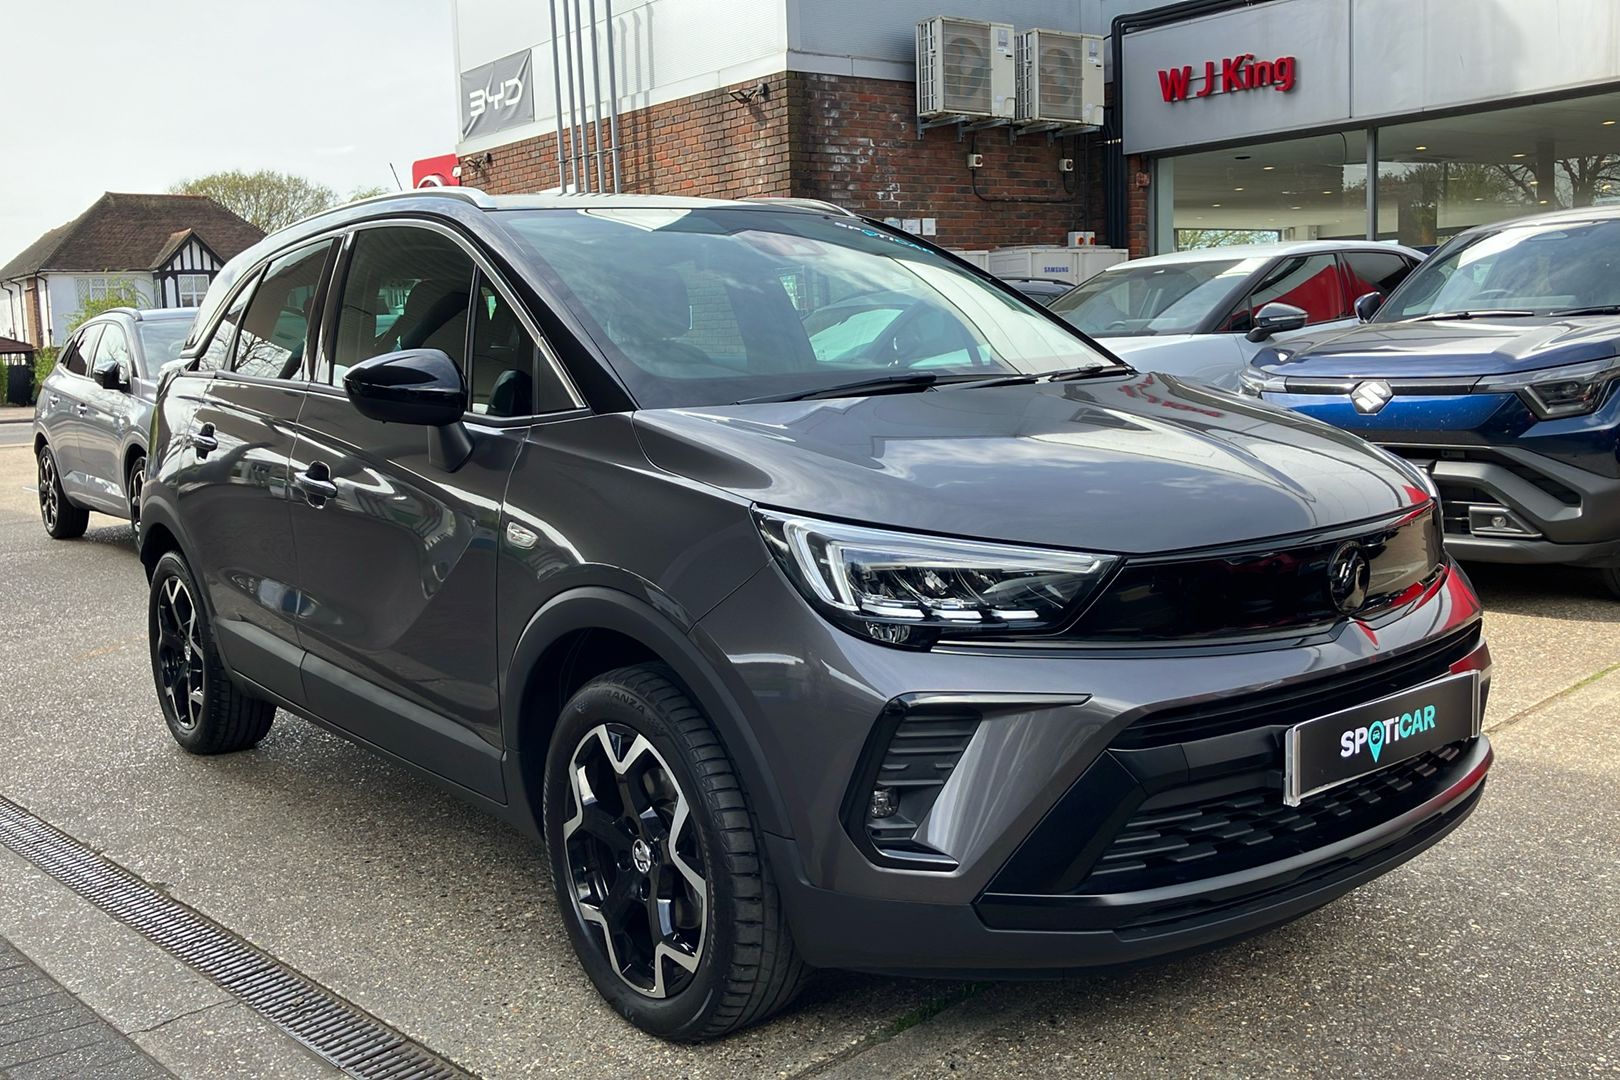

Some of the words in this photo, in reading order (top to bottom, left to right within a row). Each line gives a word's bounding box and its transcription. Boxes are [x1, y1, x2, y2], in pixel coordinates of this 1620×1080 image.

[469, 77, 522, 117] BYD
[1158, 65, 1192, 102] W
[1197, 61, 1214, 97] J
[1222, 53, 1296, 92] King
[1043, 265, 1069, 273] SAMSUNG
